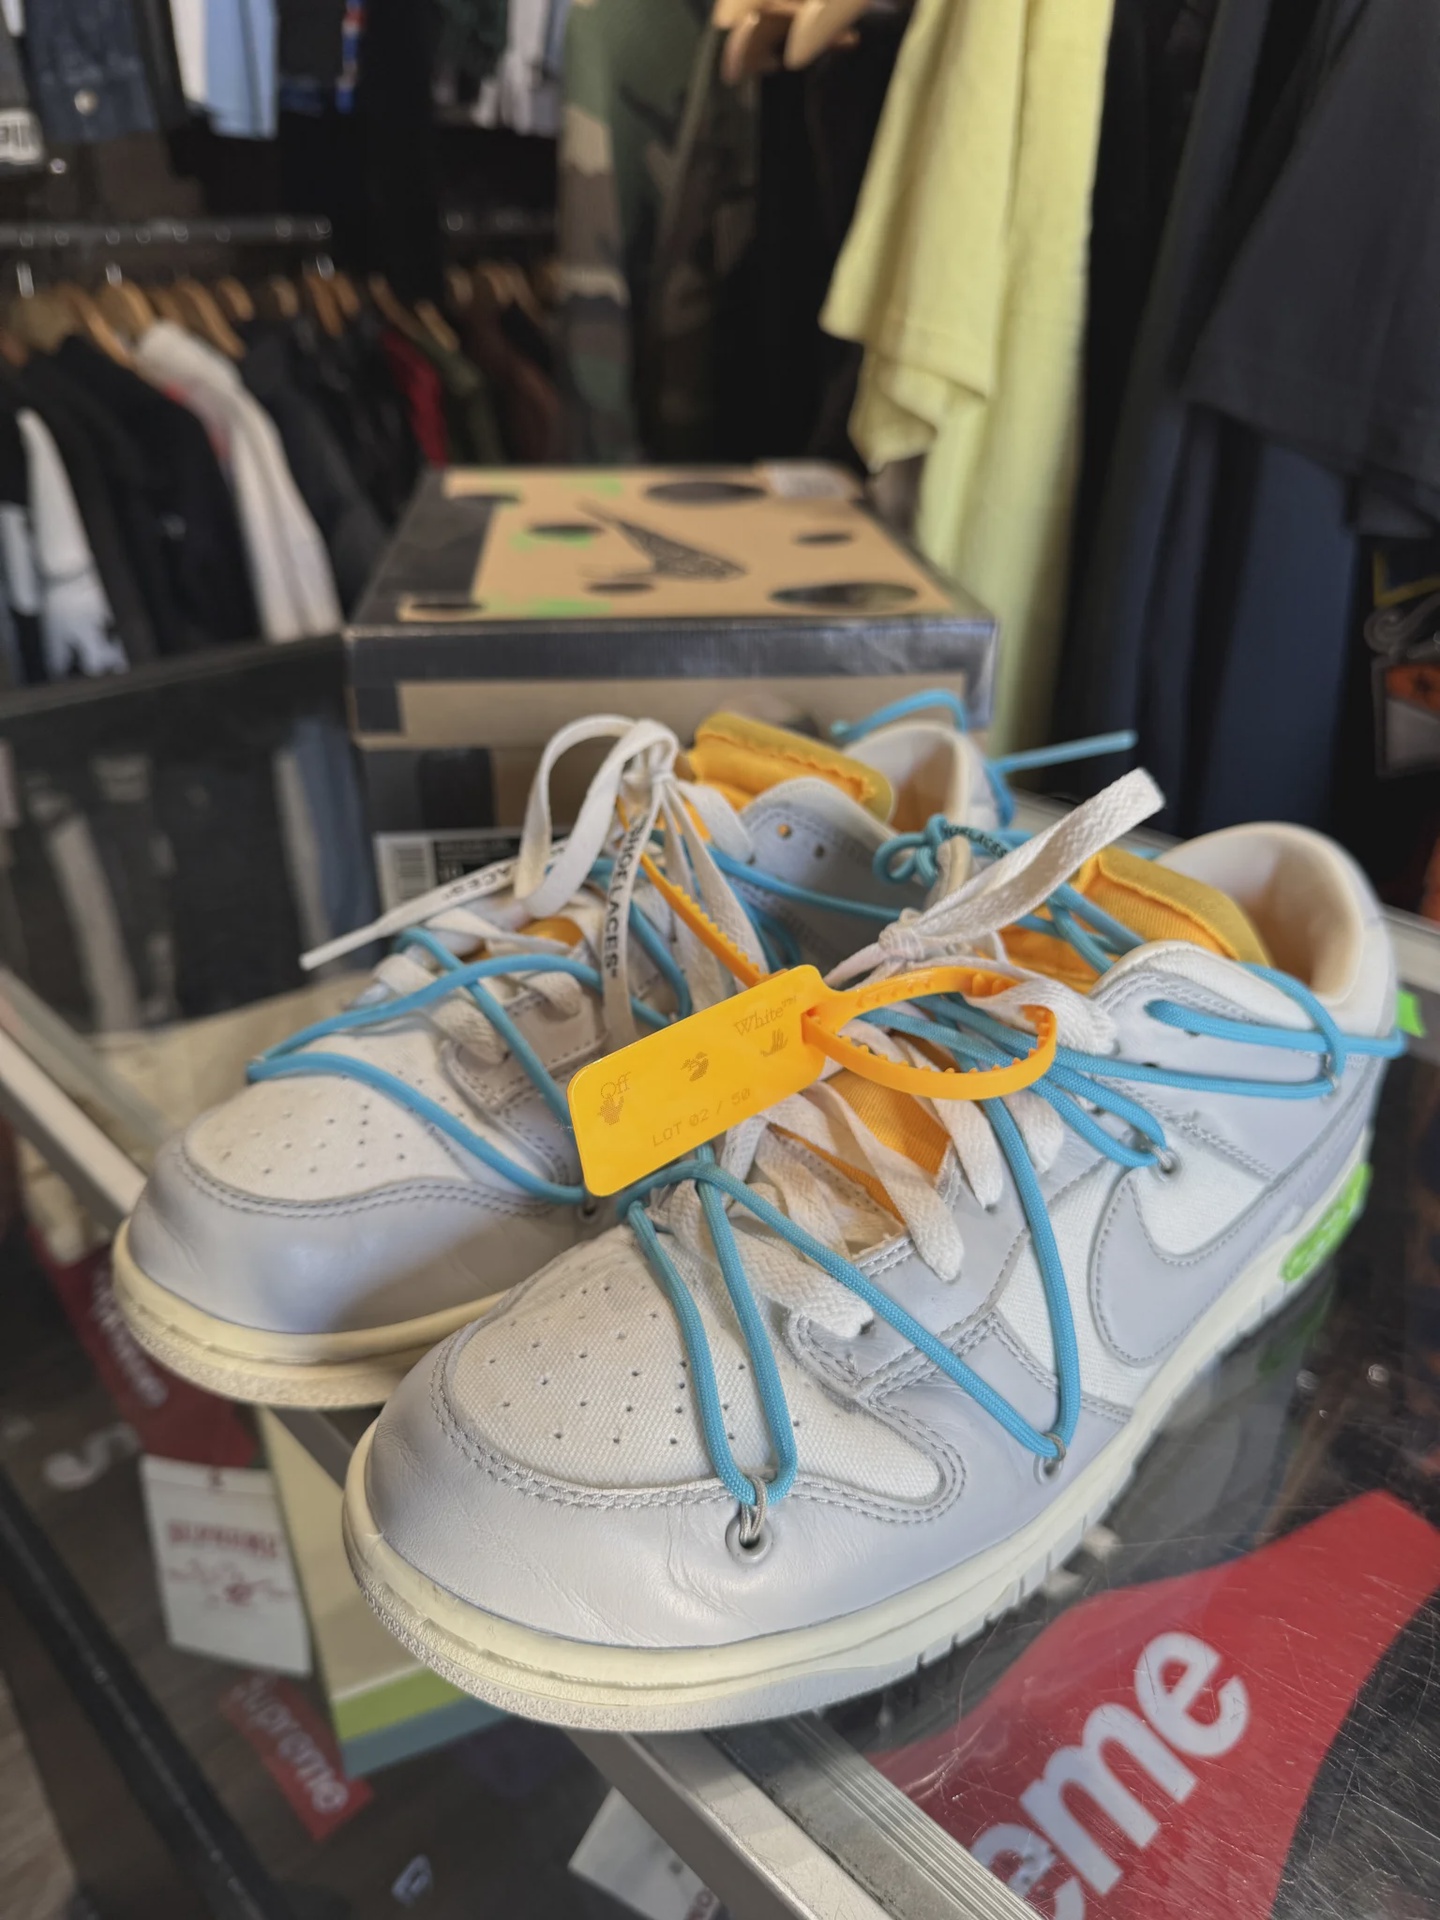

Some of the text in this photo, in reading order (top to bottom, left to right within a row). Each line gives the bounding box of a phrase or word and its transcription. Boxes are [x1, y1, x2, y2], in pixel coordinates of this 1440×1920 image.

[601, 1071, 631, 1100] Off
[652, 1120, 682, 1147] LOT
[689, 1108, 709, 1127] 02
